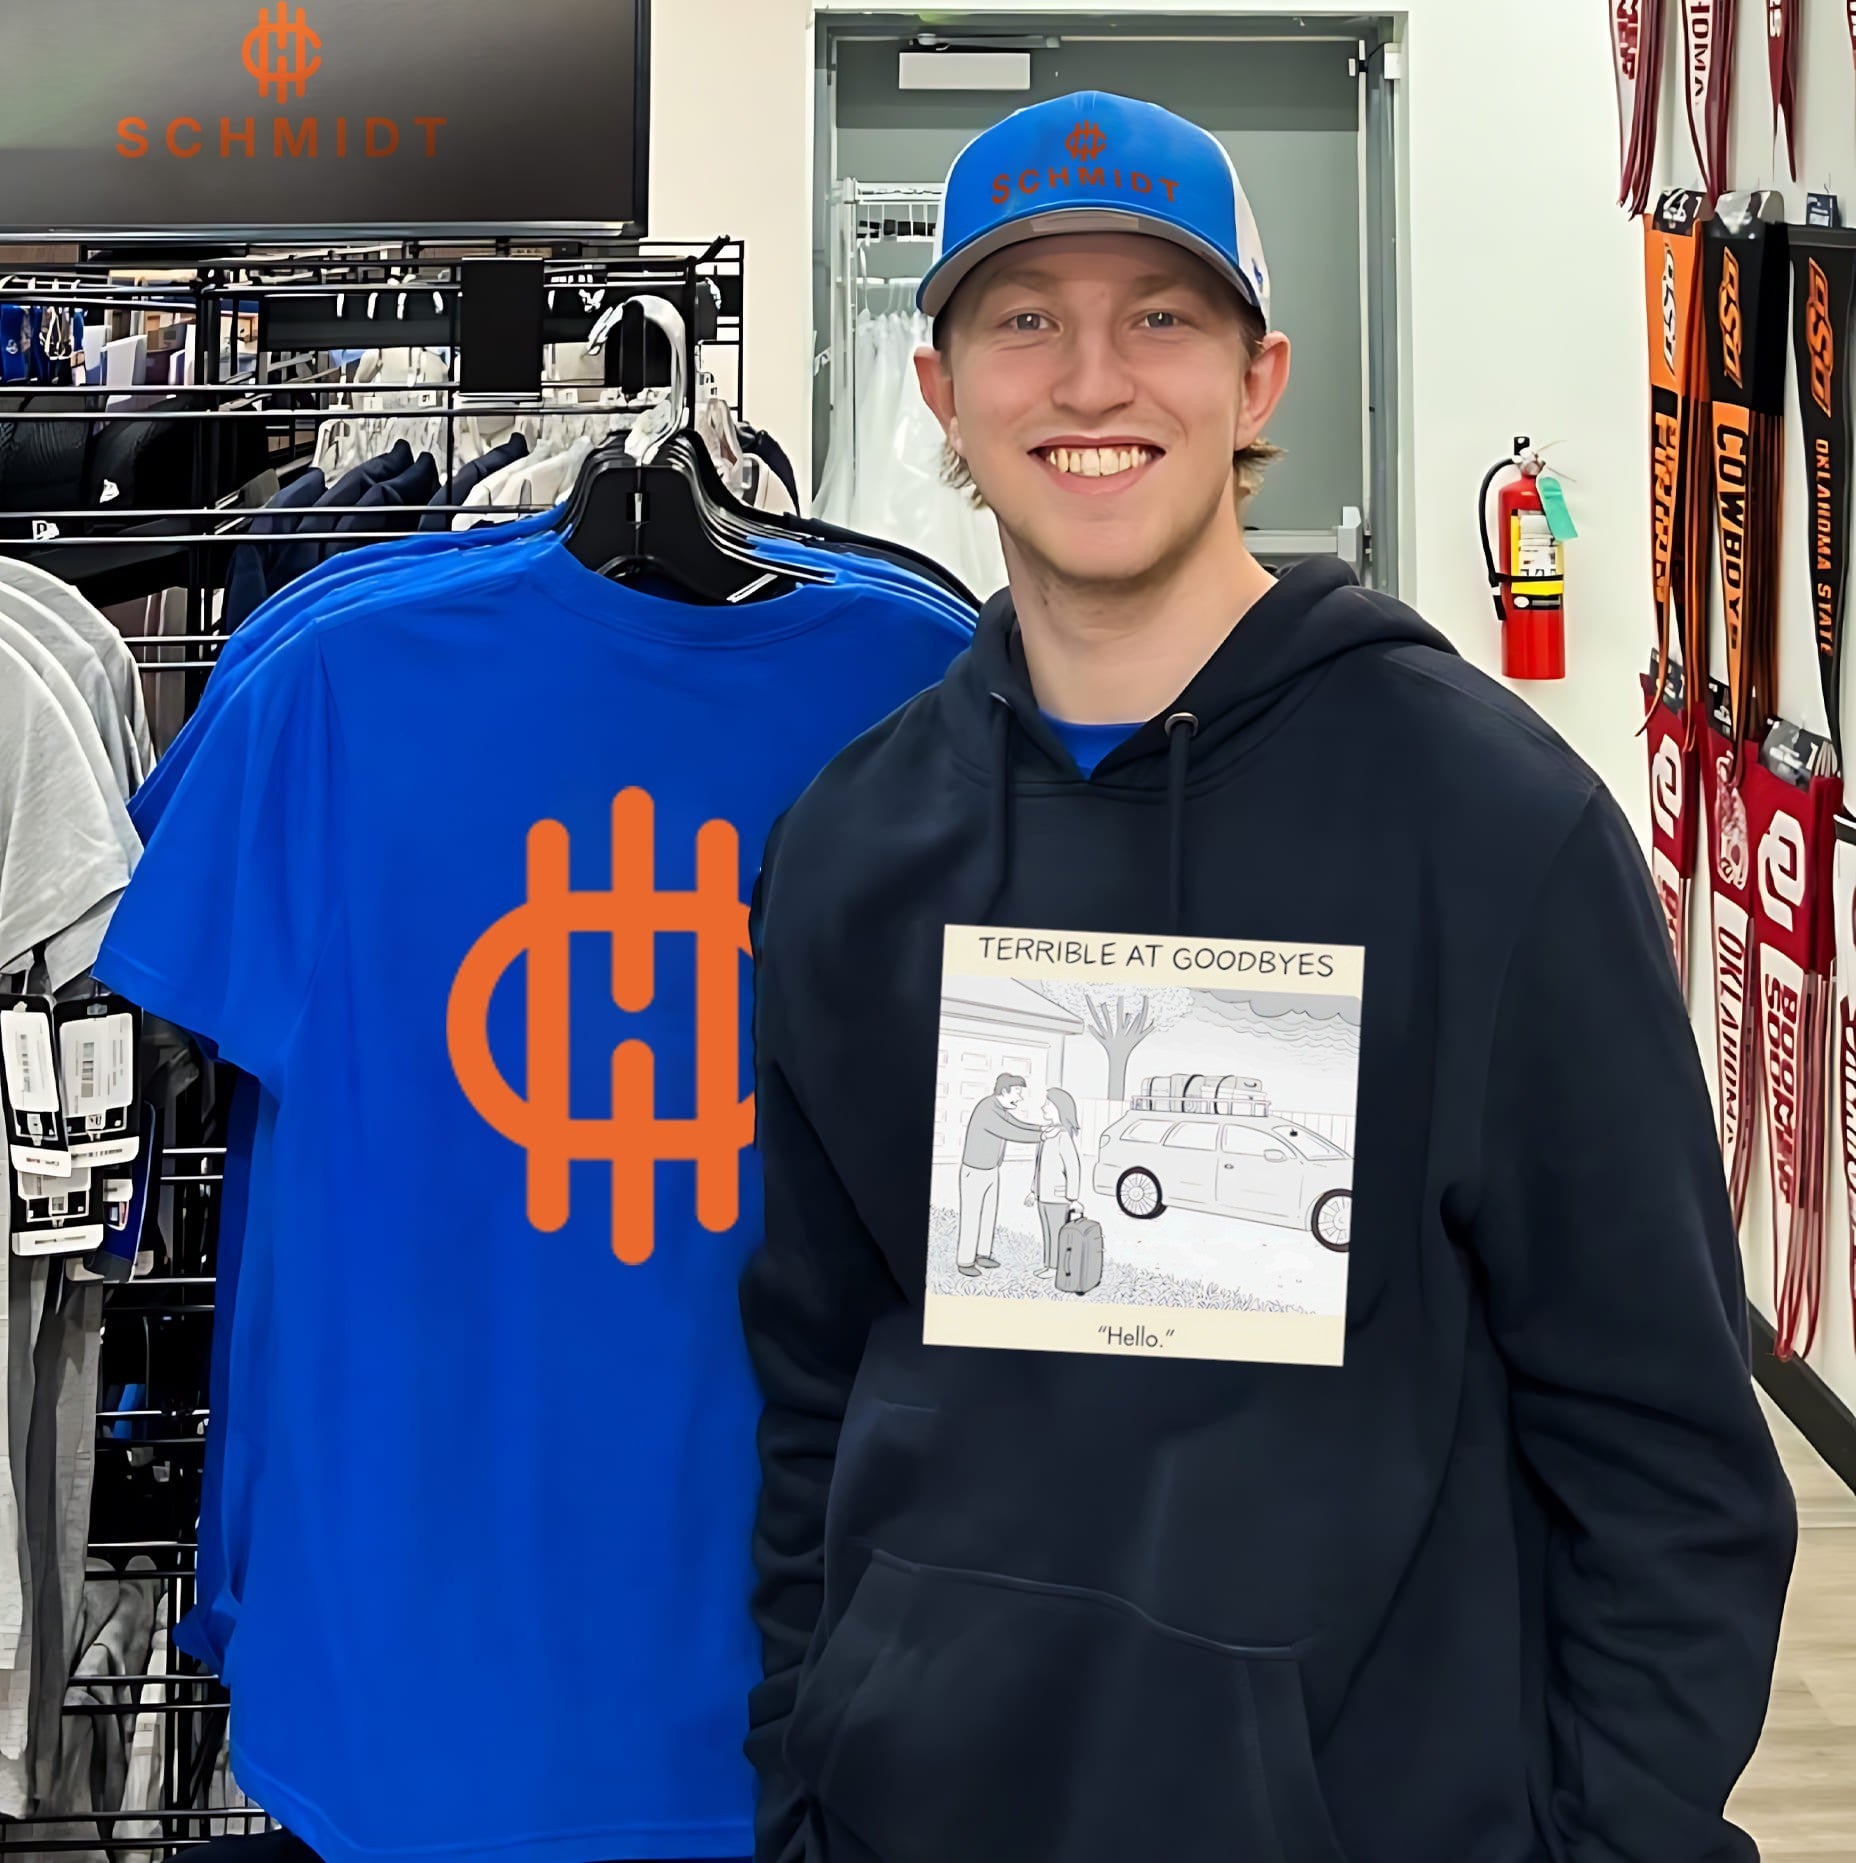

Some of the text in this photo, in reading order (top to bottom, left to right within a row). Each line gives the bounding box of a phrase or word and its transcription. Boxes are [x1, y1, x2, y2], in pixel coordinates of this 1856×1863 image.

[115, 116, 447, 159] SCHMIDT
[991, 166, 1180, 205] SCHMIDT
[1814, 438, 1832, 570] OKLAHOMA
[978, 936, 1335, 978] TERRIBLE AT GOODBYES
[1718, 925, 1746, 1145] OKLAHOMA
